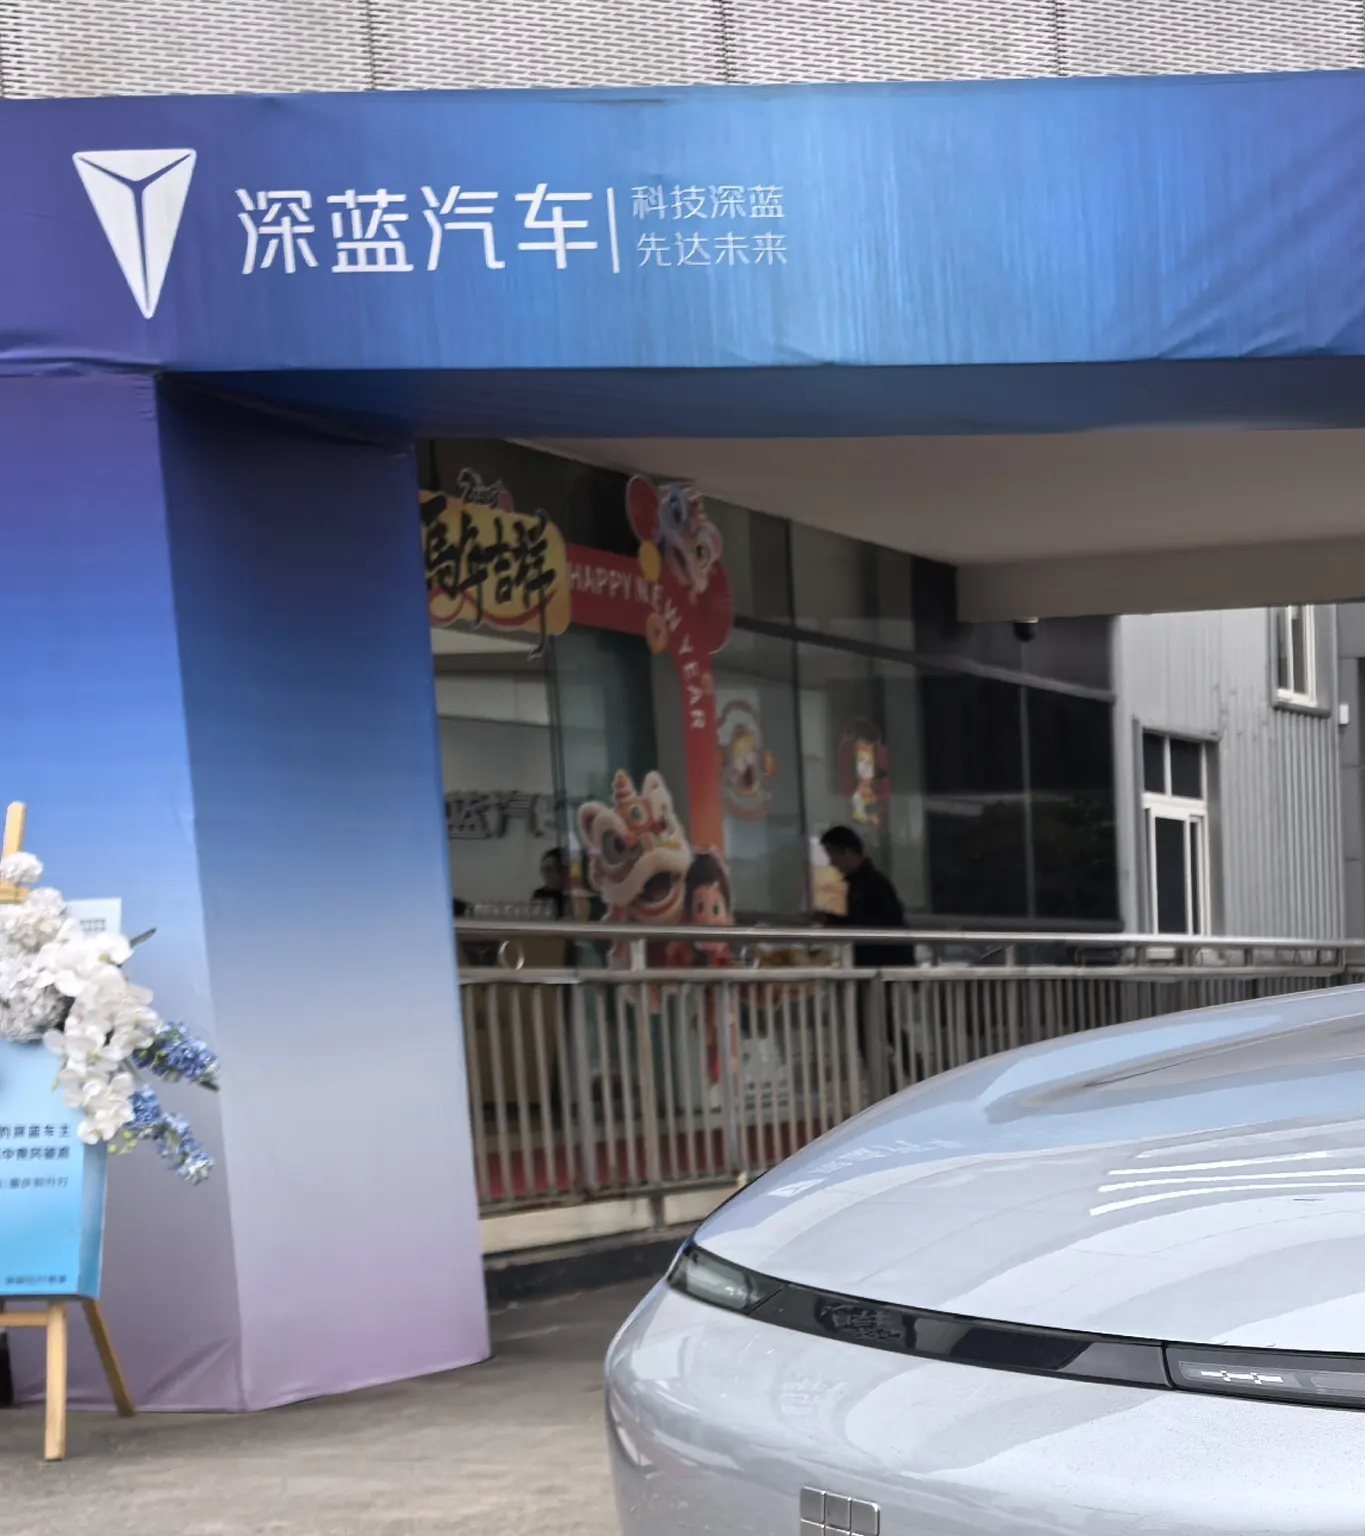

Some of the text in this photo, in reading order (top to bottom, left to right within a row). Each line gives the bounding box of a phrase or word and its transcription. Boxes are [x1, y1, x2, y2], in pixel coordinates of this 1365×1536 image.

[235, 183, 598, 274] 深蓝汽车
[631, 184, 785, 220] 科技深蓝
[636, 230, 788, 268] 先达未来
[567, 562, 631, 600] HAPPY
[678, 633, 707, 730] YEAR
